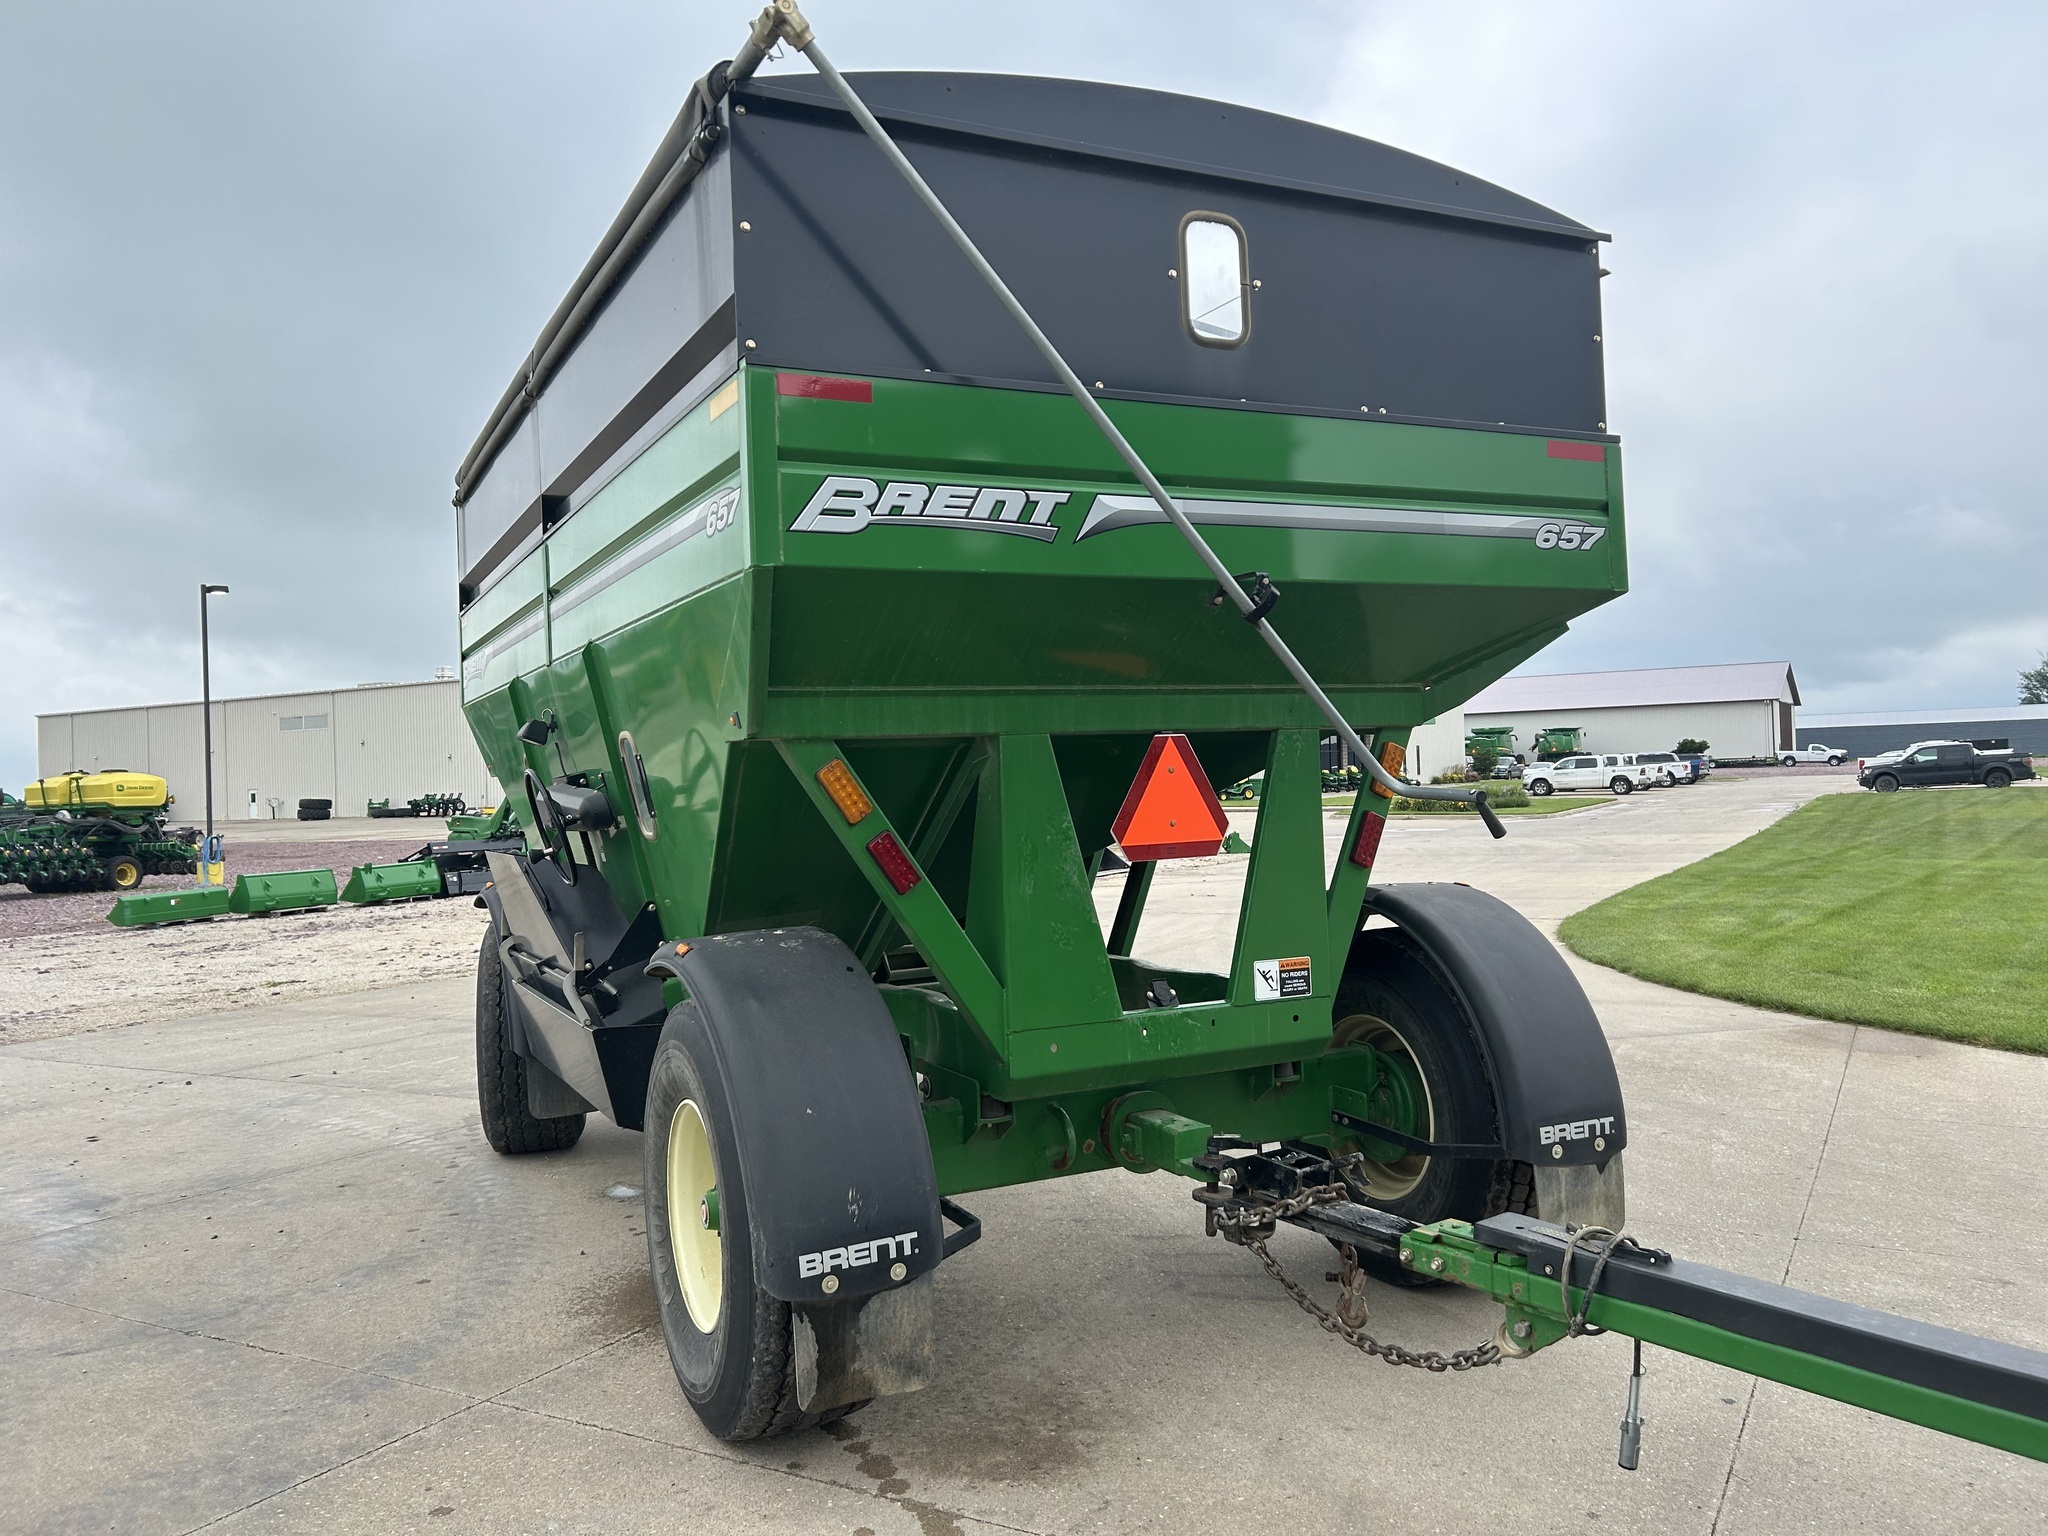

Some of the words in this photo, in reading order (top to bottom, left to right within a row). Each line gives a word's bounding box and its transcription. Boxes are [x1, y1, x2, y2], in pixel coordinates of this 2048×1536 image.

[706, 486, 741, 538] 657
[788, 475, 1073, 534] BRENT
[1535, 522, 1606, 551] 657
[1290, 970, 1308, 978] RIDERS
[1540, 1116, 1615, 1145] BRENT
[799, 1231, 919, 1279] BRENT
